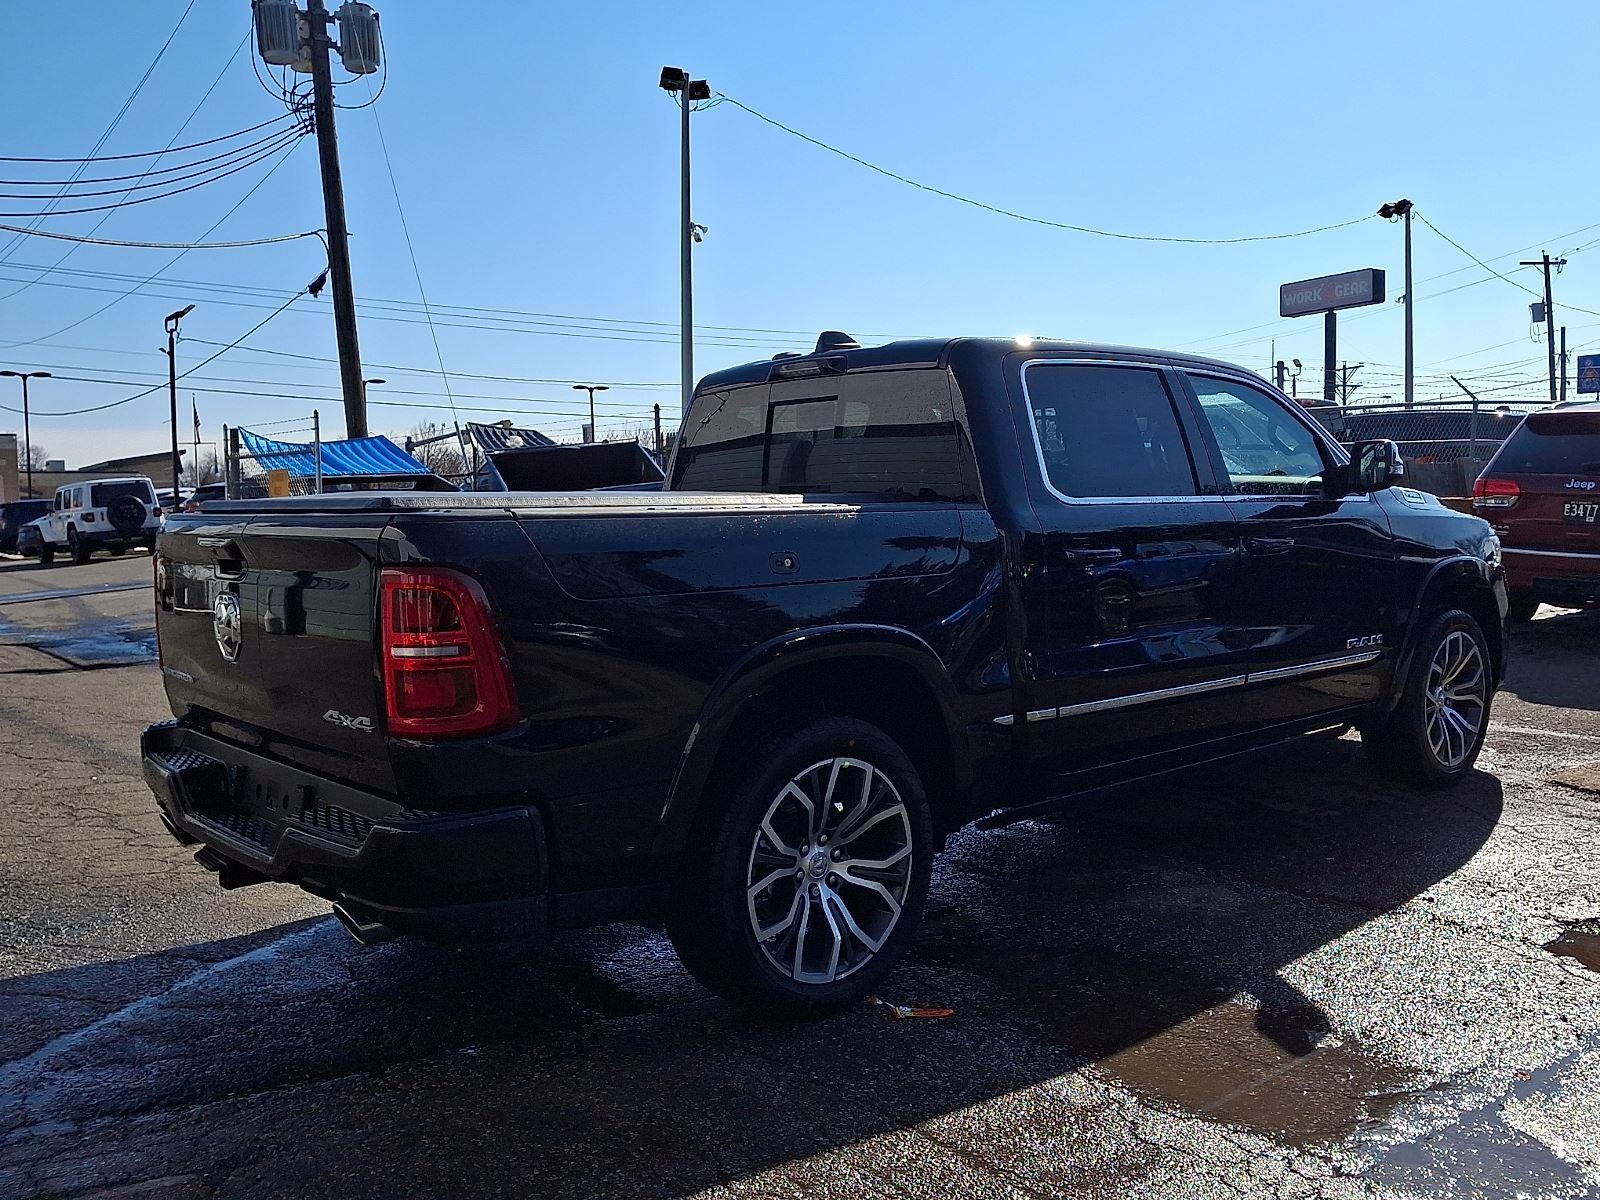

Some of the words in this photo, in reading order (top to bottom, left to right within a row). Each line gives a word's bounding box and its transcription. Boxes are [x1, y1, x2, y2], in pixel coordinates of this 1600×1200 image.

[1283, 285, 1323, 306] WORK
[1334, 281, 1369, 297] GEAR
[1565, 478, 1596, 490] Jeep
